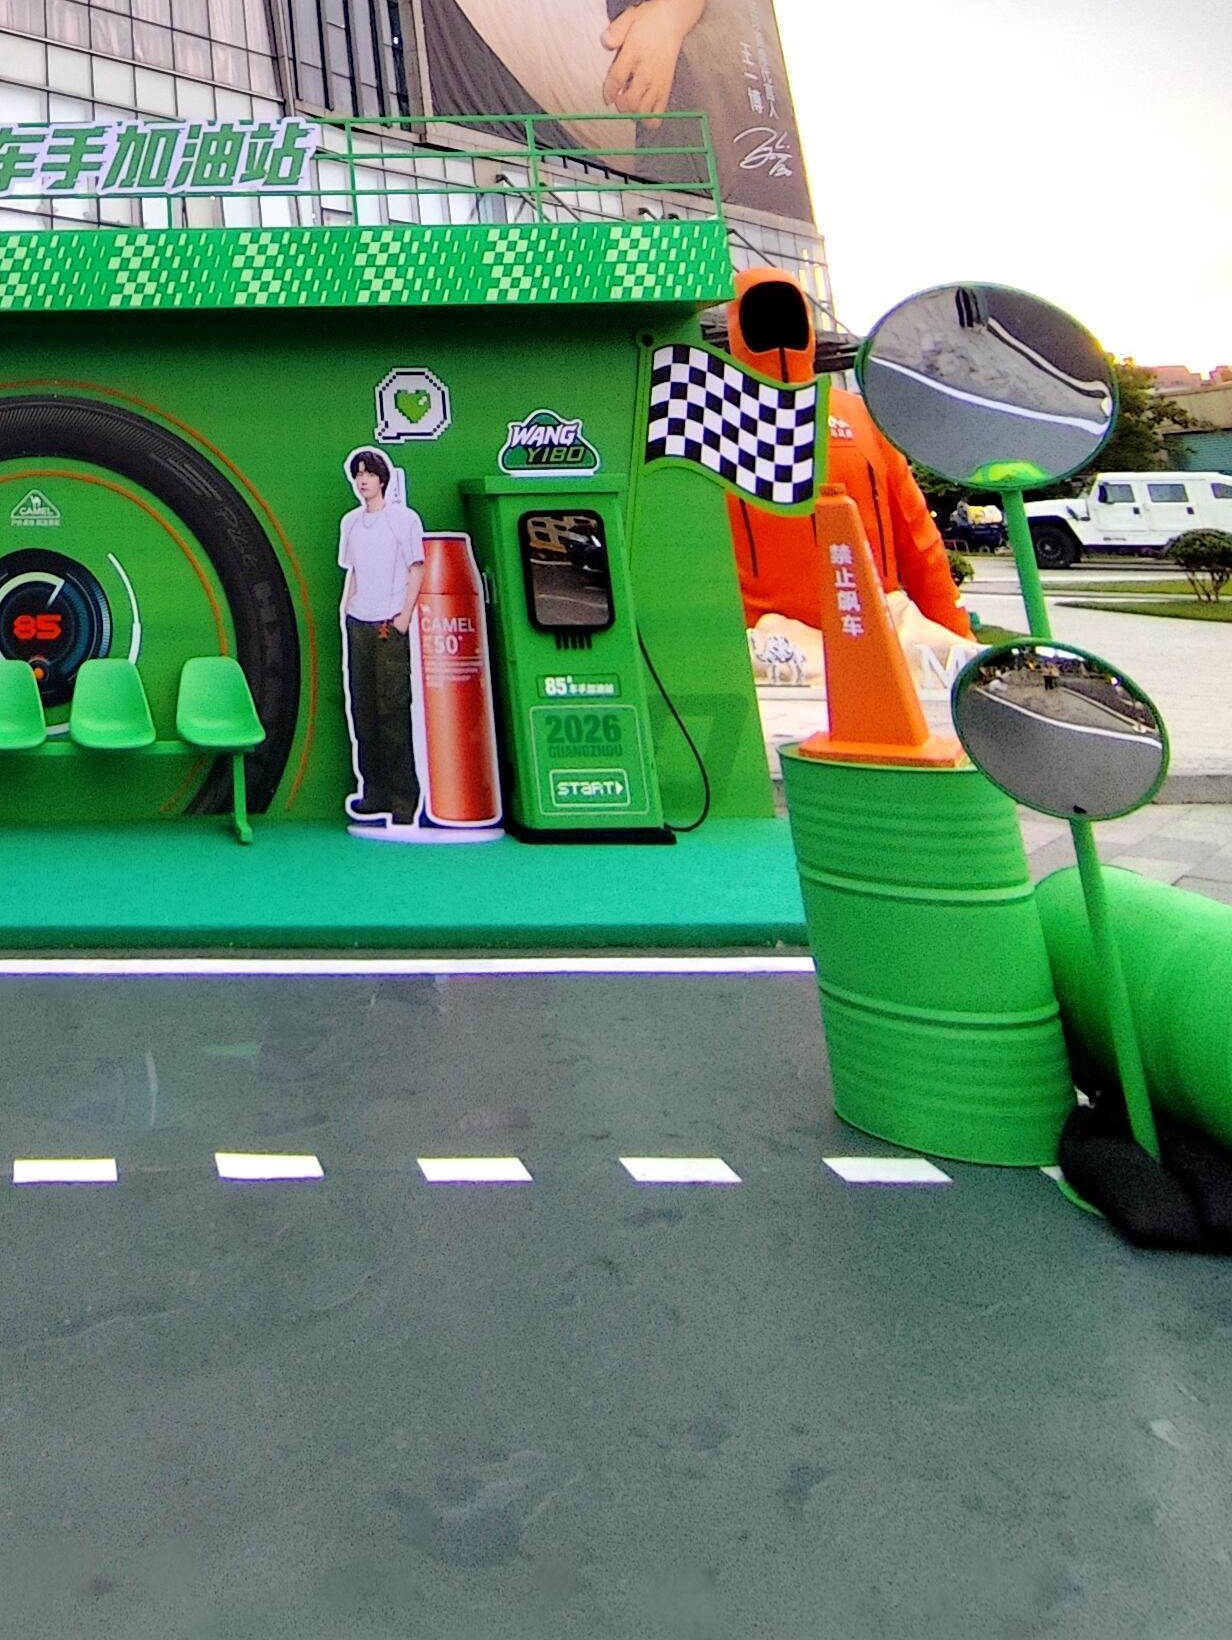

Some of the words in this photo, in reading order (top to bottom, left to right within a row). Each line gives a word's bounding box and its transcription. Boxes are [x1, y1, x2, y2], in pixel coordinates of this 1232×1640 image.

[510, 423, 579, 447] WANG
[527, 446, 586, 463] YIBO
[13, 614, 62, 640] 85
[420, 617, 476, 633] CAMEL
[545, 714, 622, 744] 2026
